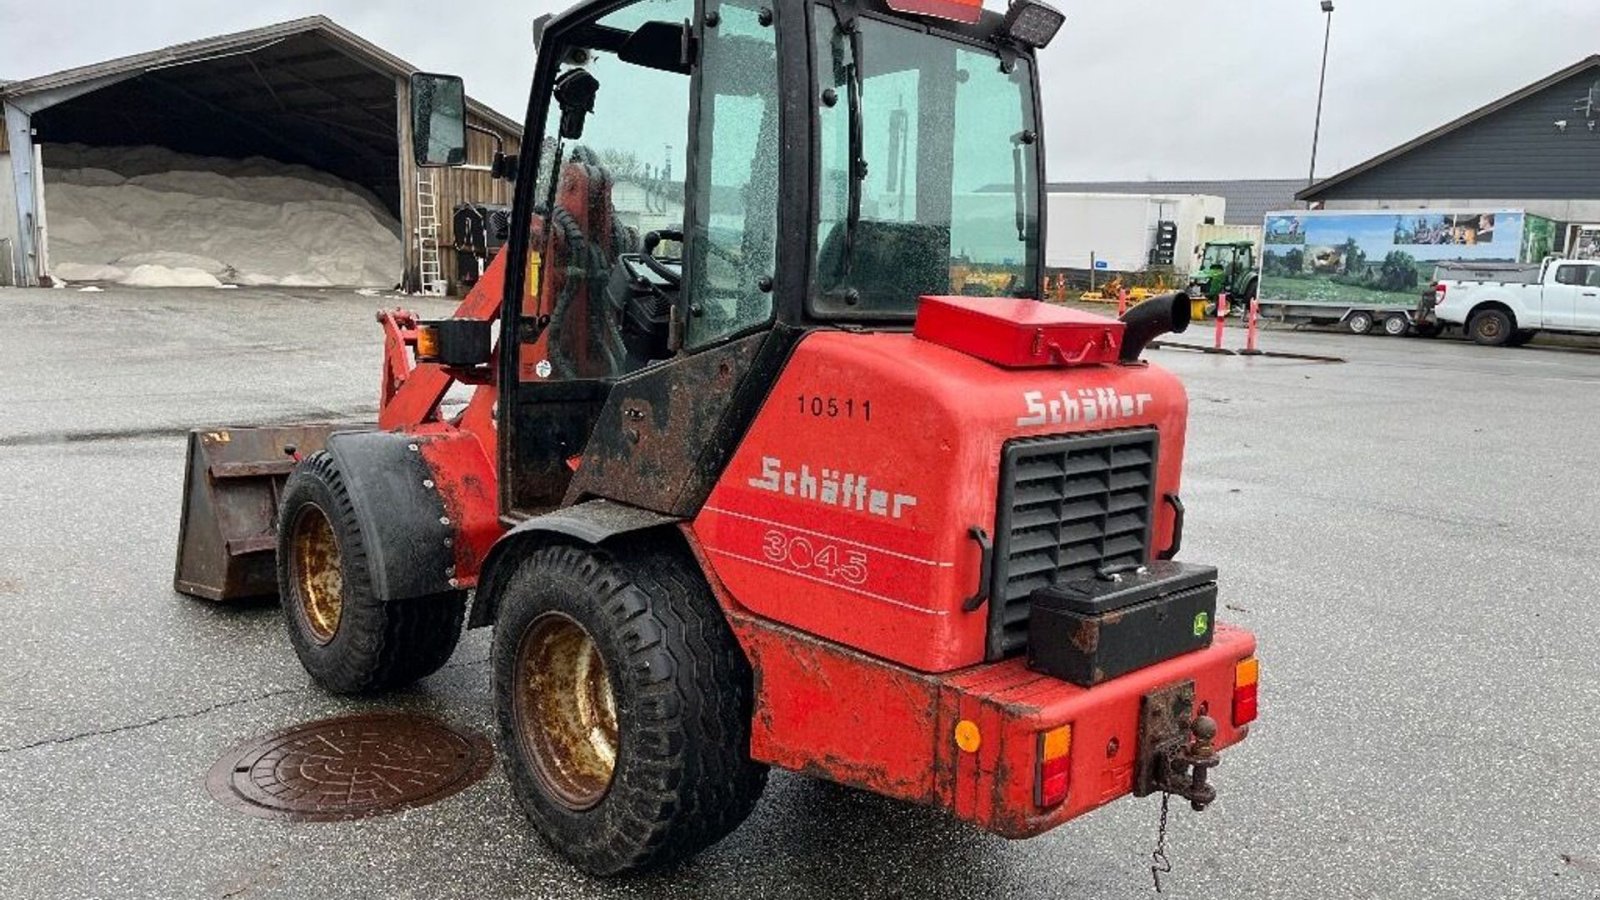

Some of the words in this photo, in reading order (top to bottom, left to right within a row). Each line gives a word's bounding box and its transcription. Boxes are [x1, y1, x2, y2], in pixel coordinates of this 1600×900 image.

[798, 394, 871, 421] 10511
[1017, 387, 1152, 426] Schäffer
[749, 456, 917, 518] Schäffer
[763, 530, 868, 584] 3045
